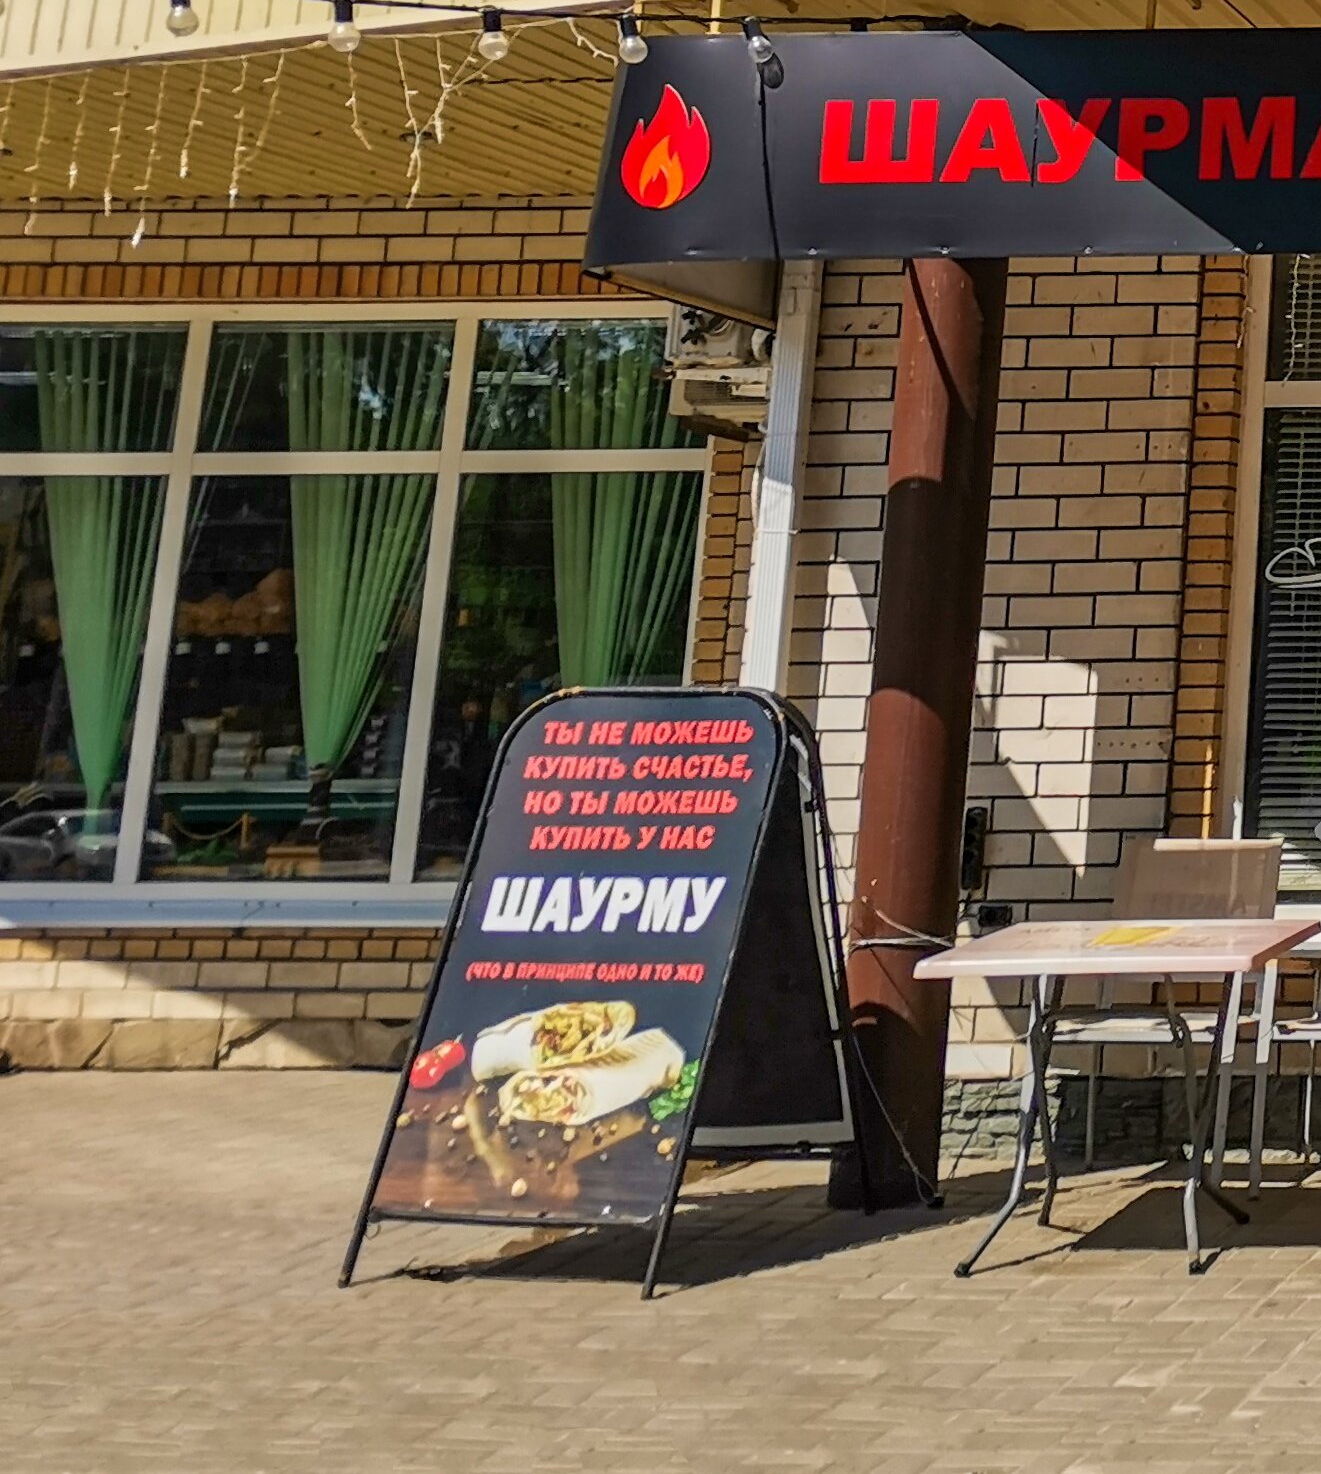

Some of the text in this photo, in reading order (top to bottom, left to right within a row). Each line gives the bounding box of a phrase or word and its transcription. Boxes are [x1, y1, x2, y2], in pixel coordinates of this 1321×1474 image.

[544, 720, 754, 745] ТЫ НЕ МОЖЕШЬ
[523, 754, 754, 783] КУПИТЬ СЧАСТЬЕ,
[523, 789, 739, 815] НО ТЫ МОЖЕШЬ
[529, 825, 716, 850] КУПИТЬ У НАС
[481, 876, 727, 933] ШАУРМУ
[465, 961, 501, 982] (ЧТО
[516, 962, 596, 982] ПРИНЦИПЕ
[596, 962, 638, 982] ОДНО
